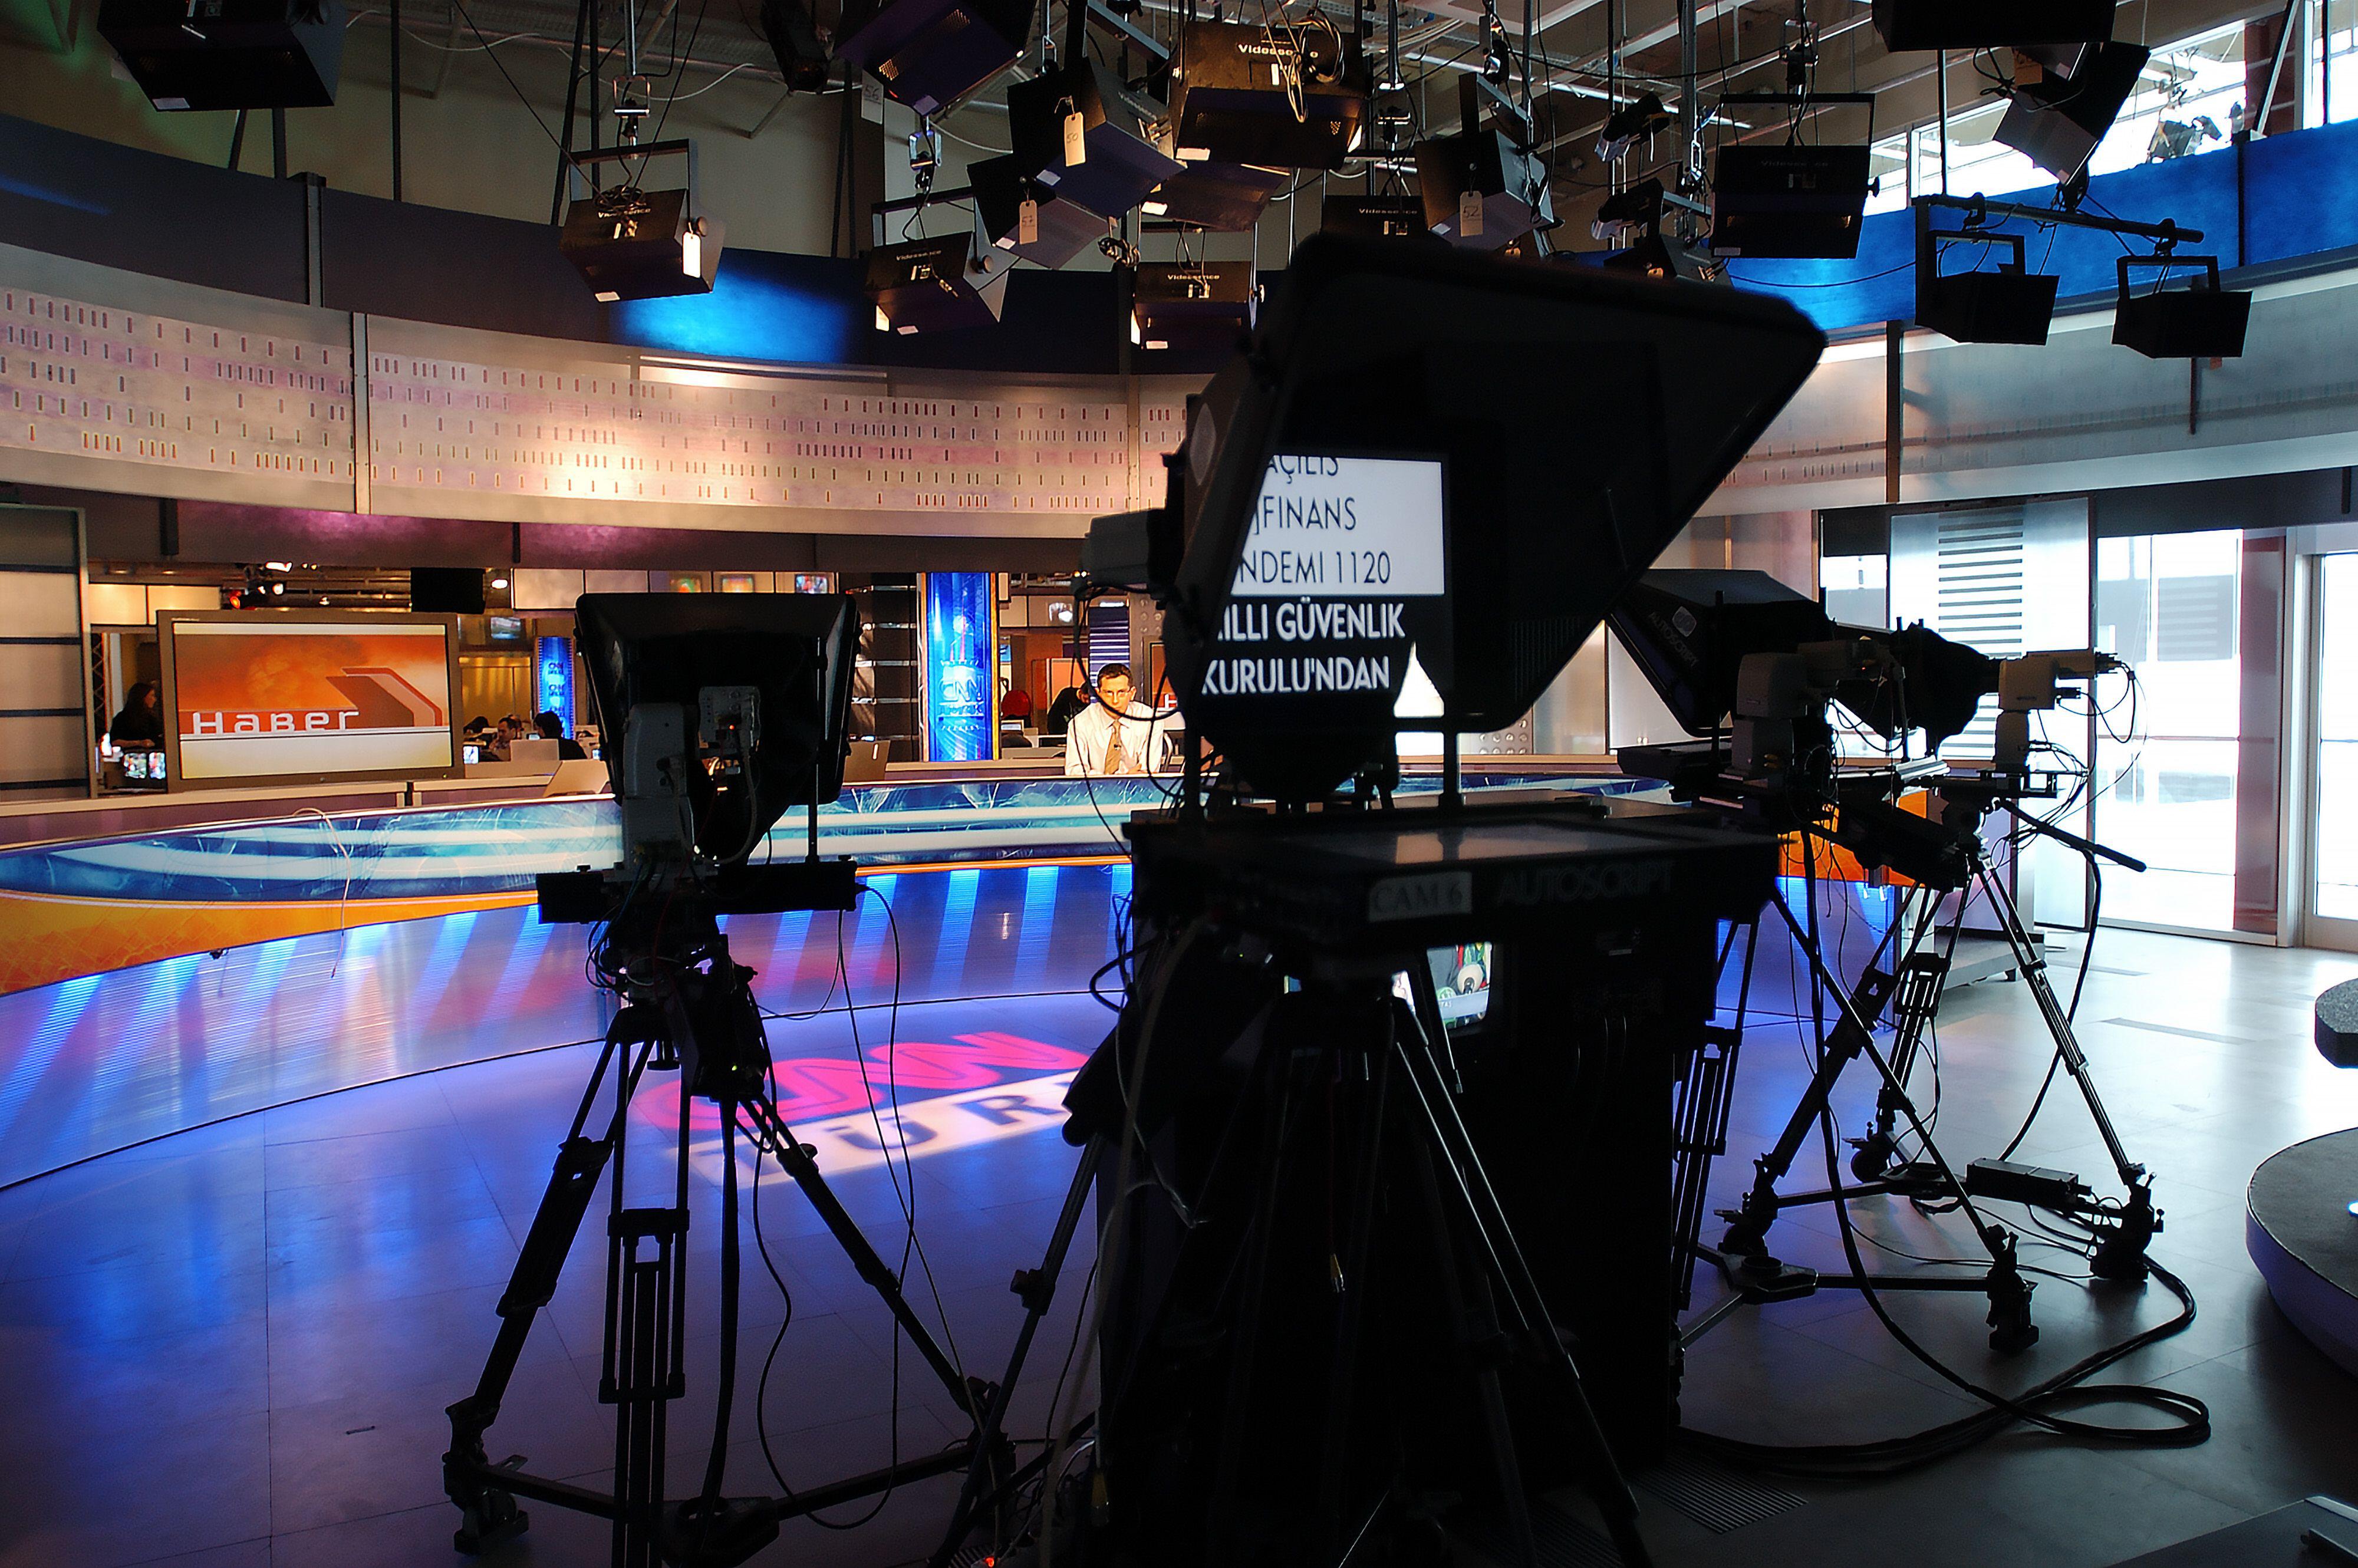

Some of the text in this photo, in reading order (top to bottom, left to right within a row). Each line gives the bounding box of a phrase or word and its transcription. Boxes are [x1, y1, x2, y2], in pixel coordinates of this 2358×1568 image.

[1336, 551, 1391, 584] 1120
[1217, 603, 1269, 641] ILLI
[1275, 595, 1406, 642] GÜVENLIK
[1372, 882, 1440, 913] CAM
